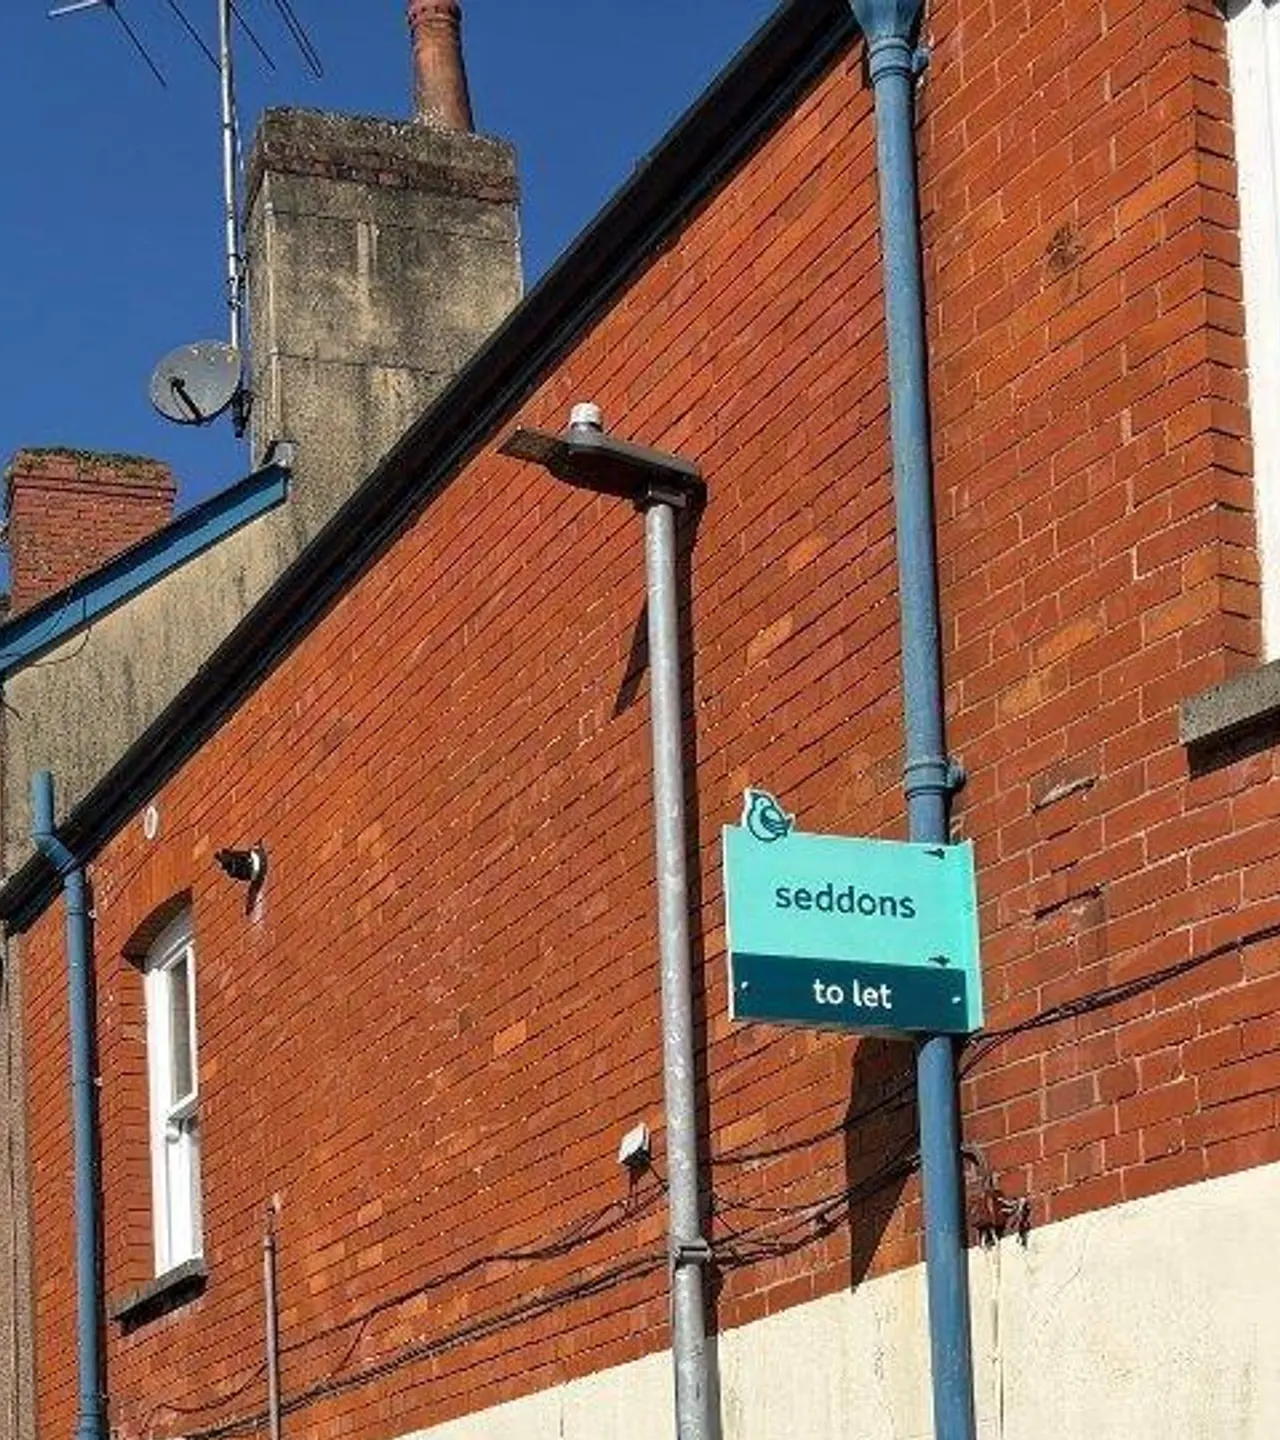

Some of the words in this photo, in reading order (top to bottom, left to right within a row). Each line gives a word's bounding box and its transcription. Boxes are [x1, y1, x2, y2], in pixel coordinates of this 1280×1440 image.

[775, 883, 916, 918] seddons
[812, 979, 844, 1005] to
[852, 979, 892, 1009] let
